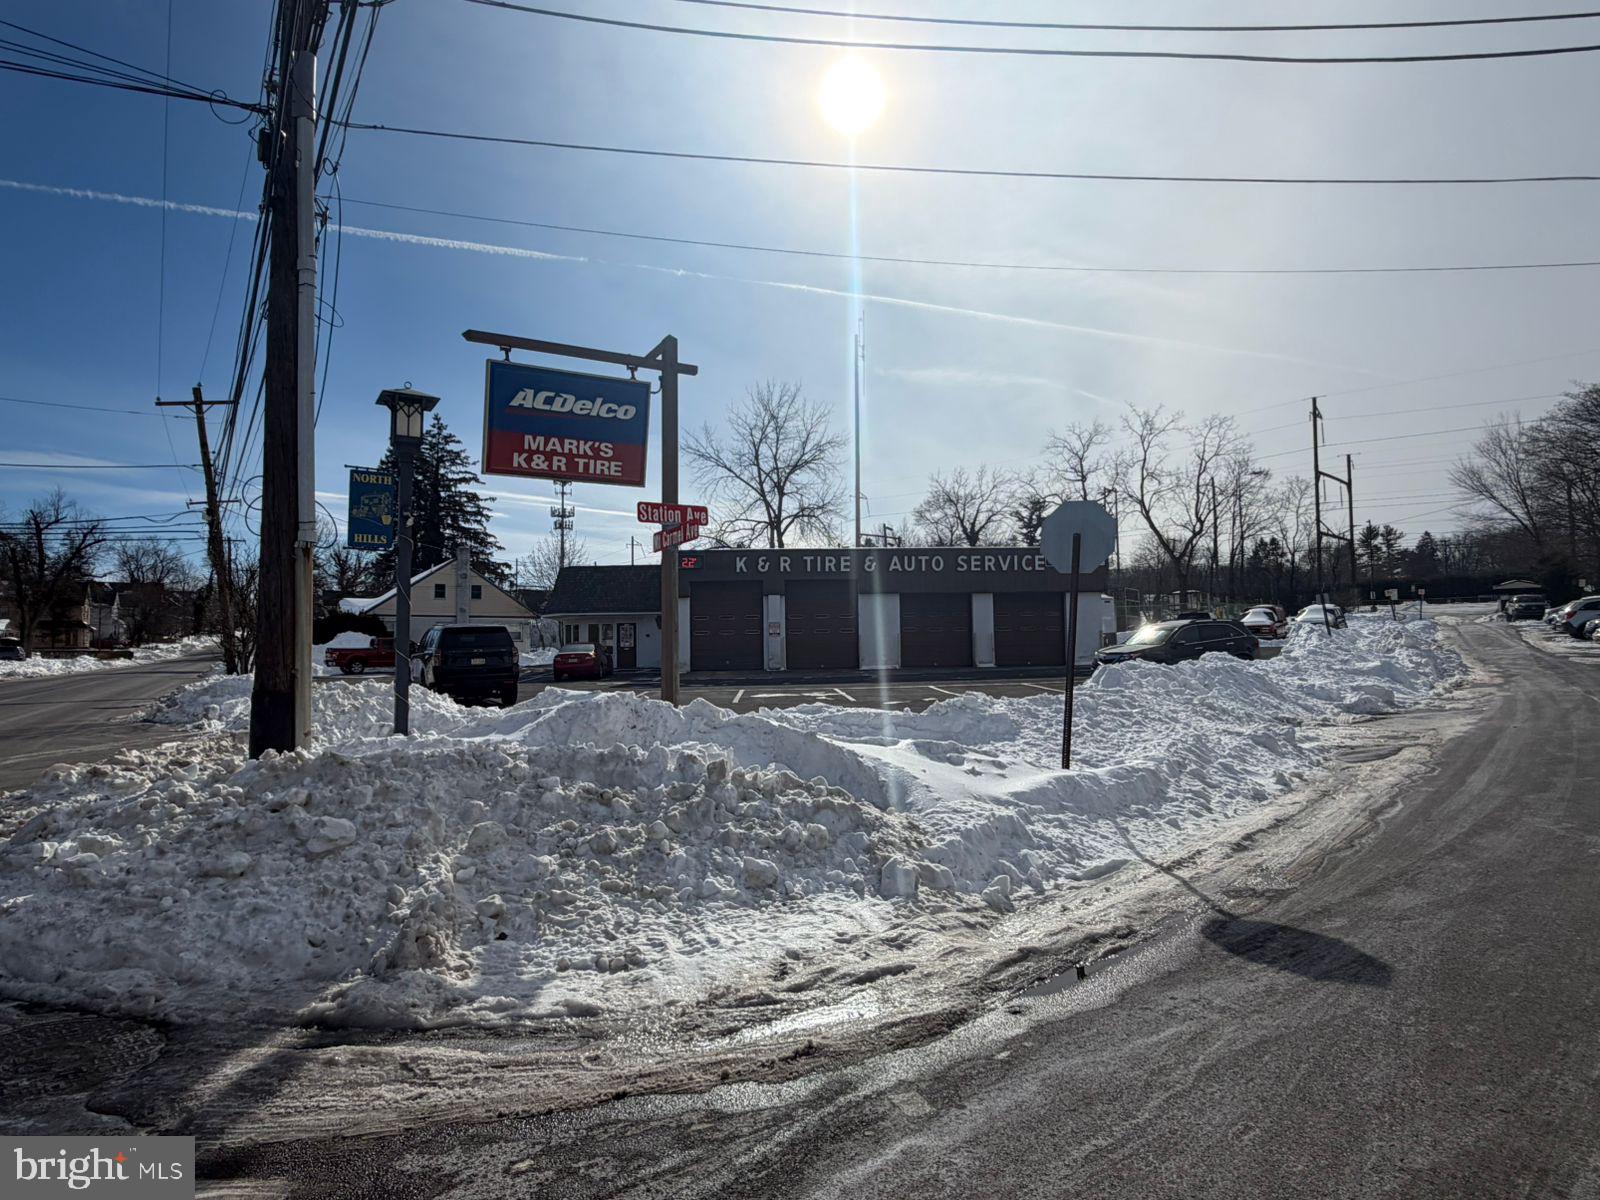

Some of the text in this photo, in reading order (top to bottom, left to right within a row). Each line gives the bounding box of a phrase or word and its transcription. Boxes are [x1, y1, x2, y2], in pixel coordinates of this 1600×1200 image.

[509, 388, 636, 420] ACDelco
[524, 434, 614, 458] MARK'S
[512, 452, 622, 476] K&R TIRE
[353, 473, 392, 485] NORTH
[640, 504, 706, 524] Station Ave
[354, 534, 387, 544] HILLS
[736, 555, 1045, 572] K & R TIRE & AUTO SERVICE
